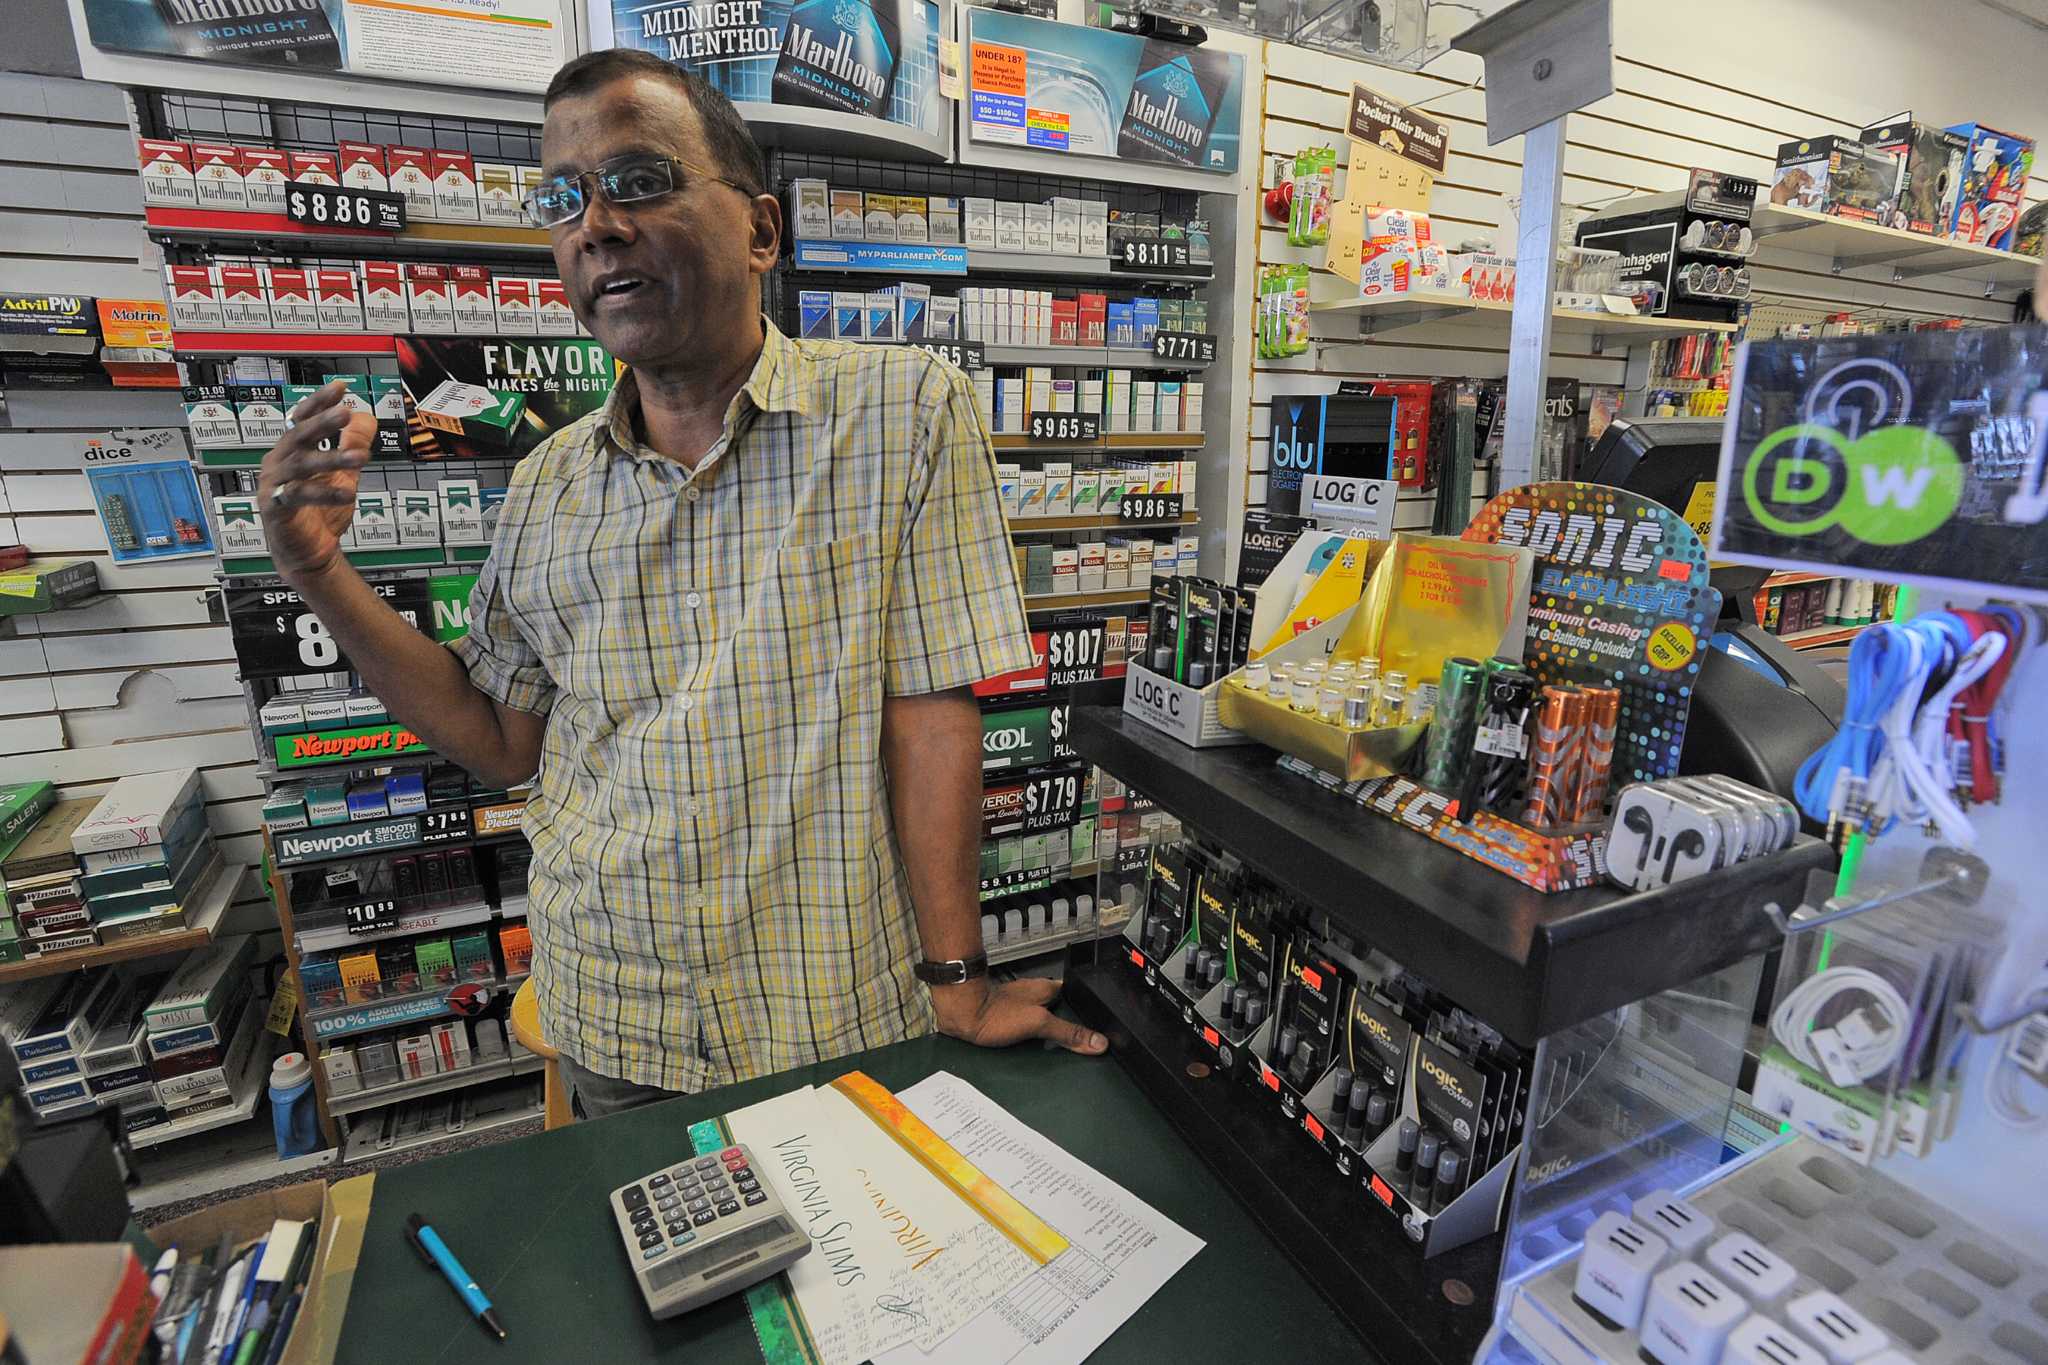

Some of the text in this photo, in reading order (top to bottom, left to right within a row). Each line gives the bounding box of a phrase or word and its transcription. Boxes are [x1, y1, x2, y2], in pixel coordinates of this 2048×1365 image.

[641, 1, 763, 38] MIDNIGHT
[199, 19, 308, 40] MIDNIGHT
[215, 33, 332, 52] UNIQUE MENTHOL FLAVOR
[668, 27, 784, 61] MENTHOL
[784, 23, 886, 98] Marlboro
[975, 49, 1022, 64] UNDER 18?
[792, 66, 871, 107] MIDNIGHT
[1128, 90, 1202, 147] Marlboro
[1357, 99, 1391, 125] Pocket
[1391, 115, 1414, 135] Hair
[1413, 125, 1442, 148] Brush
[1132, 123, 1190, 154] MIDNIGHT
[1781, 152, 1824, 167] Smithsonian
[147, 178, 194, 198] Marlboro
[199, 179, 244, 201] Marlboro
[439, 191, 474, 207] Marlboro
[379, 203, 399, 213] Plus
[381, 212, 398, 221] Tax
[1386, 215, 1408, 228] Clear
[1388, 227, 1408, 237] eyes
[1623, 251, 1669, 270] nhagen
[2, 297, 76, 311] Advil PM
[176, 303, 219, 321] Marlboro
[367, 303, 406, 320] Marlboro
[414, 304, 451, 320] Marlboro
[112, 307, 161, 321] Motrin
[225, 304, 268, 322] Marlboro
[274, 304, 315, 323] Marlboro
[320, 305, 360, 323] Marlboro
[456, 305, 493, 321] Marlboro
[501, 311, 533, 324] Marlboro
[540, 311, 572, 324] Marlboro
[483, 346, 606, 377] FLAVOR
[199, 386, 225, 396] $1.00
[251, 387, 276, 396] $1.00
[487, 378, 610, 392] MAKES the NIGHT.
[195, 421, 237, 437] Marlboro
[245, 421, 285, 437] Marlboro
[380, 430, 399, 438] Plus
[1033, 417, 1079, 439] $9.65
[84, 447, 132, 461] dice
[1273, 425, 1313, 469] blu
[1123, 500, 1165, 519] $9.86
[1245, 533, 1285, 548] LOGIC
[1498, 506, 1664, 572] SONIC
[1179, 552, 1197, 560] Basic
[1108, 562, 1128, 570] Basic
[1529, 607, 1642, 640] uminum Casing
[1050, 628, 1101, 667] $8.07
[1552, 628, 1636, 660] Batteries Included
[1660, 628, 1690, 659] EXCELLENT
[1653, 644, 1674, 666] GRIP!
[1051, 669, 1096, 684] PLUS TAX
[307, 707, 342, 718] Newport
[349, 703, 383, 714] Newport
[264, 712, 300, 723] Newport
[292, 731, 390, 759] Newport
[393, 794, 425, 804] Newport
[1026, 776, 1076, 814] $7.79
[313, 804, 345, 814] Newport
[352, 810, 386, 820] Newport
[6, 801, 39, 834] SALEM
[1027, 811, 1070, 829] PLUS TAX
[269, 820, 304, 832] Newport
[91, 832, 125, 844] CAPRI
[283, 823, 417, 857] Newport SMOOTH
[375, 832, 416, 843] SELECT
[423, 830, 467, 842] PLUS TAX
[107, 850, 141, 865] MISTY
[1154, 857, 1176, 882] logic.
[26, 886, 72, 902] Winston
[984, 880, 1042, 899] SALEM
[1201, 888, 1225, 914] logic.
[38, 911, 82, 926] Winston
[350, 921, 394, 933] PLUS TAX
[41, 937, 91, 952] Winston
[1237, 922, 1262, 951] logic.
[161, 1010, 191, 1024] MISTY
[314, 1014, 366, 1033] 100%
[1356, 1005, 1392, 1041] logic.
[166, 1034, 200, 1048] Parliament
[24, 1042, 63, 1057] Parliament
[32, 1065, 70, 1080] Parliament
[1421, 1053, 1463, 1093] logic.
[103, 1075, 138, 1088] Parliament
[162, 1079, 203, 1095] CARLTON
[39, 1089, 77, 1103] Parliament
[1442, 1084, 1474, 1110] POWER
[772, 1134, 866, 1288] VIRGINIA SLIMS
